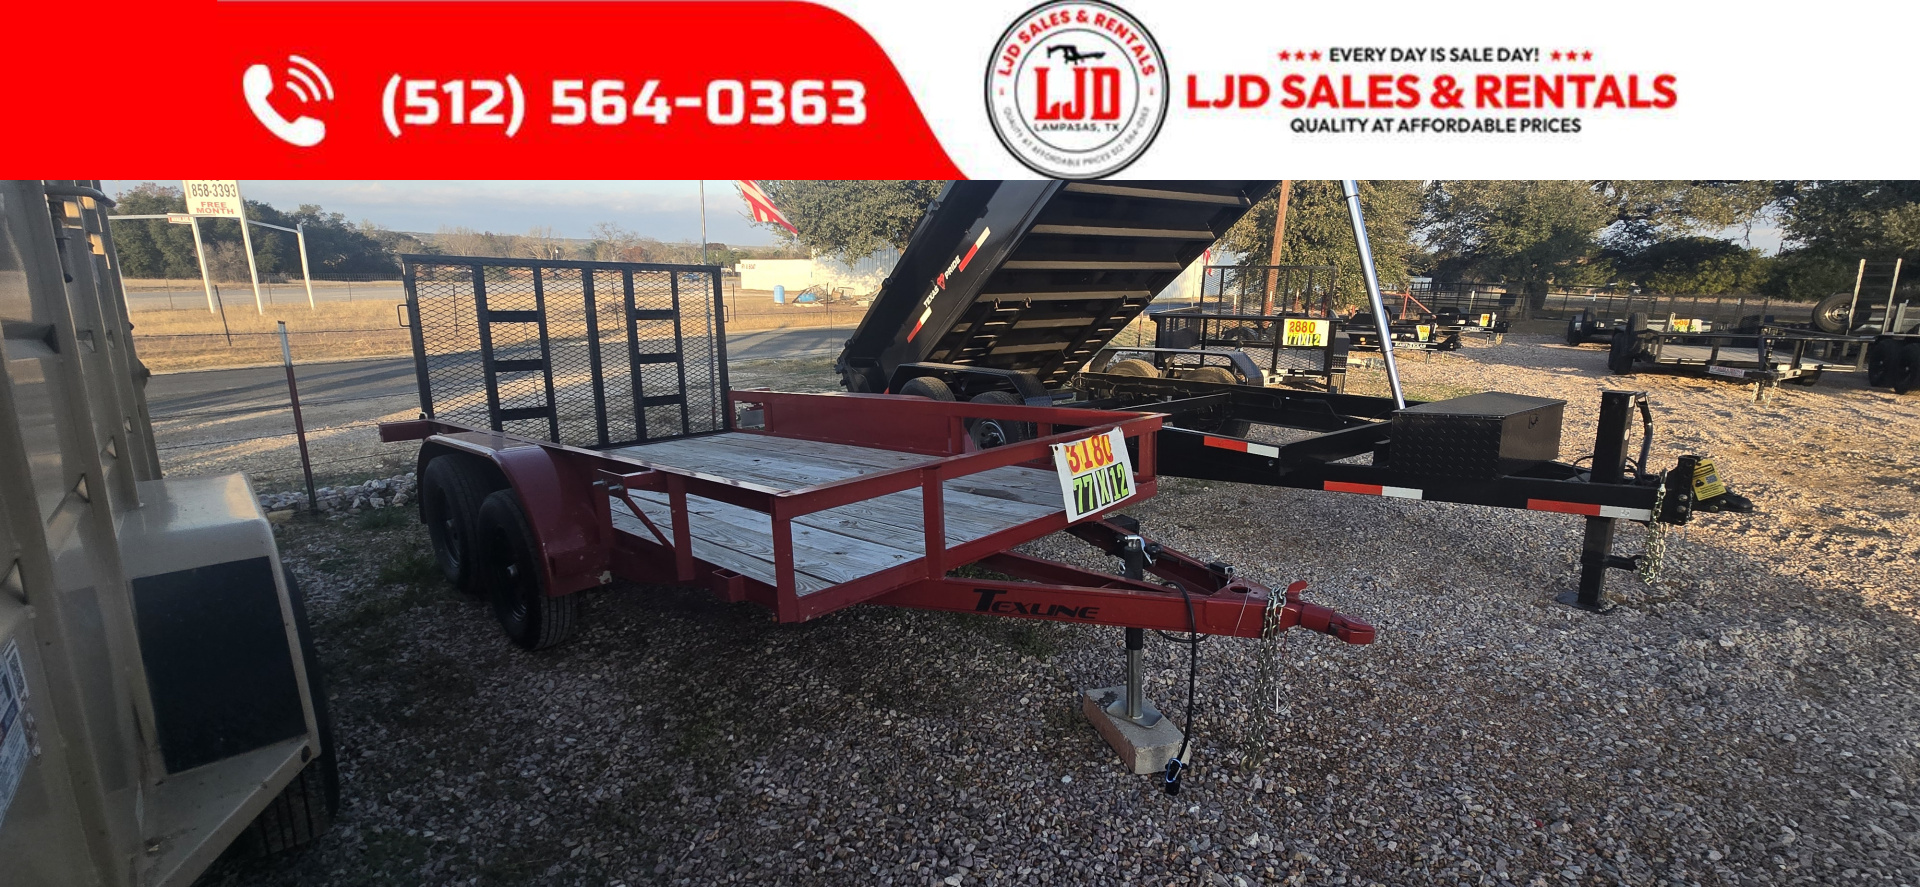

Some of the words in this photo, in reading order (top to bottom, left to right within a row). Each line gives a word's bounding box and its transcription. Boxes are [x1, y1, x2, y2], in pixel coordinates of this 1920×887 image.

[191, 183, 236, 197] 858-3393
[923, 285, 940, 308] TEXAS
[944, 254, 961, 280] PRIDE
[1289, 321, 1316, 333] 2880
[1064, 434, 1114, 473] 3180
